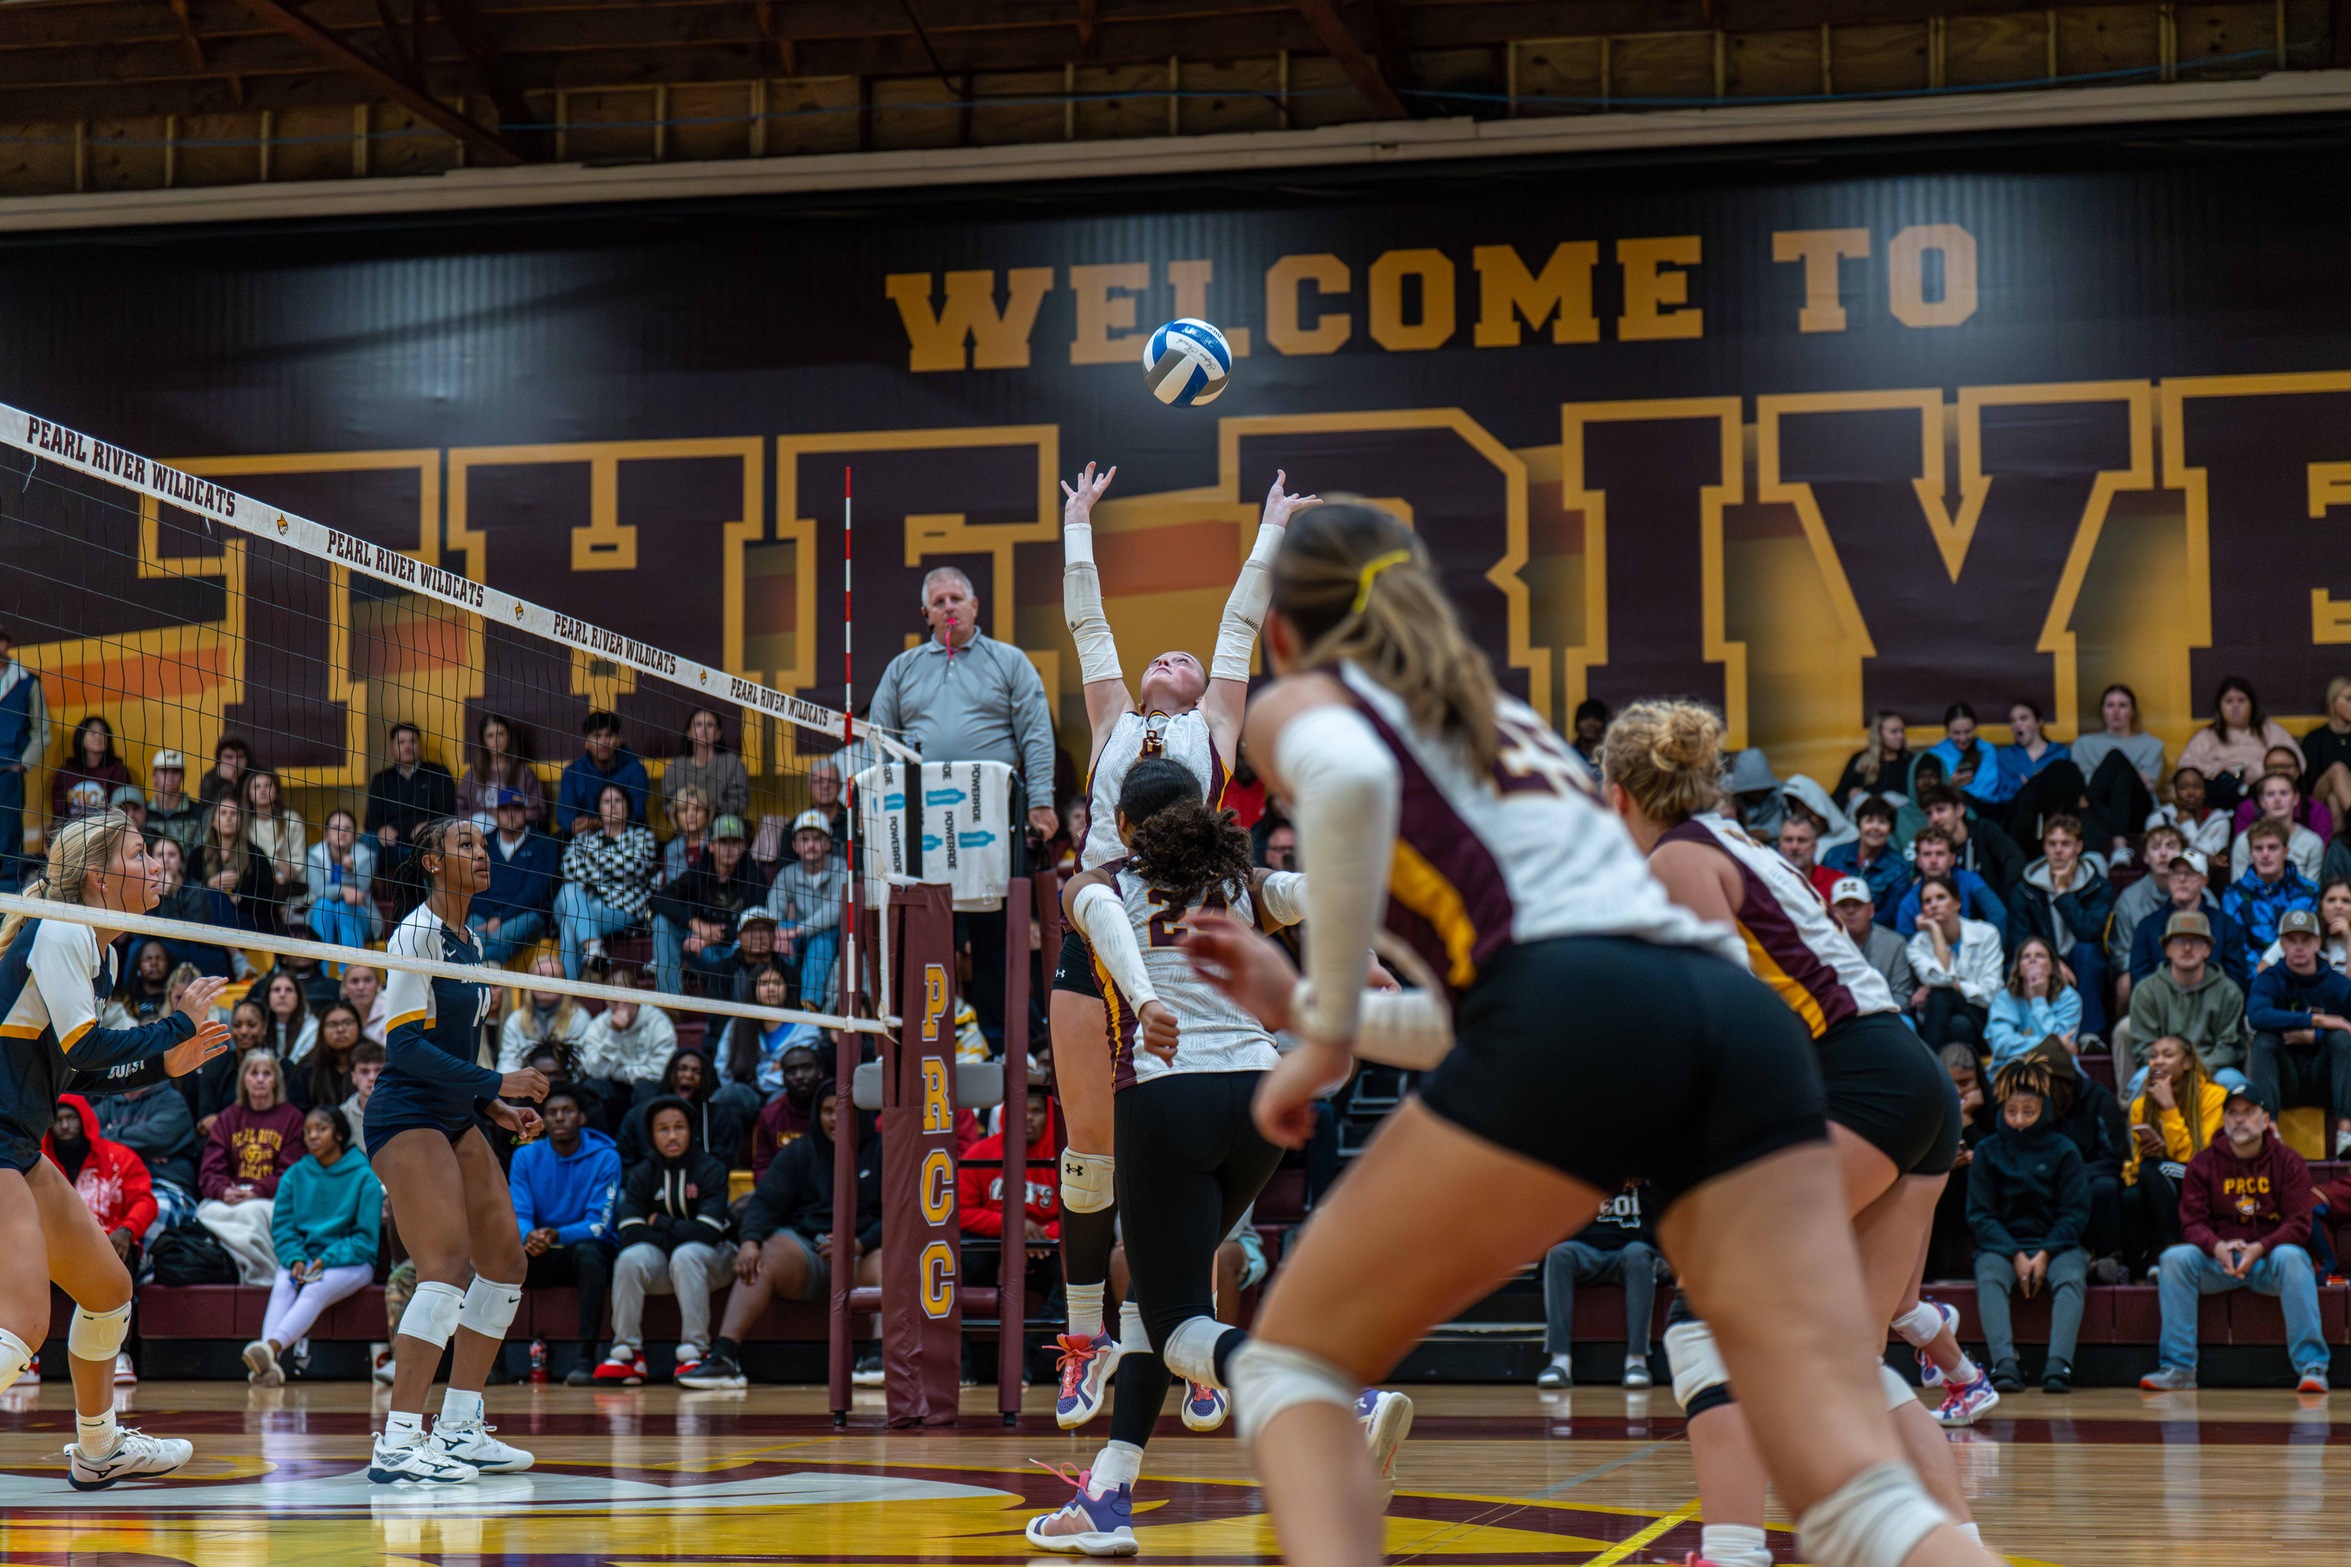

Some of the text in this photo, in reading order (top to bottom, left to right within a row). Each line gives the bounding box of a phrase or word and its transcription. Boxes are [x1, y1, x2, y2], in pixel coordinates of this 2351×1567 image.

[886, 223, 1979, 373] WELCOME TO
[27, 415, 236, 517] PEARL RIVER WILDCATS
[327, 529, 484, 607] PEARL RIVER WILDCATS
[553, 613, 676, 676] PEARL RIVER WILDCATS
[730, 677, 829, 727] PEARL RIVER WILDCATS
[972, 763, 981, 823] POWERADE
[889, 816, 902, 874] POWERADE
[944, 811, 957, 870] POWERADE
[920, 963, 955, 1319] PRCC
[2223, 1176, 2270, 1195] PRCC
